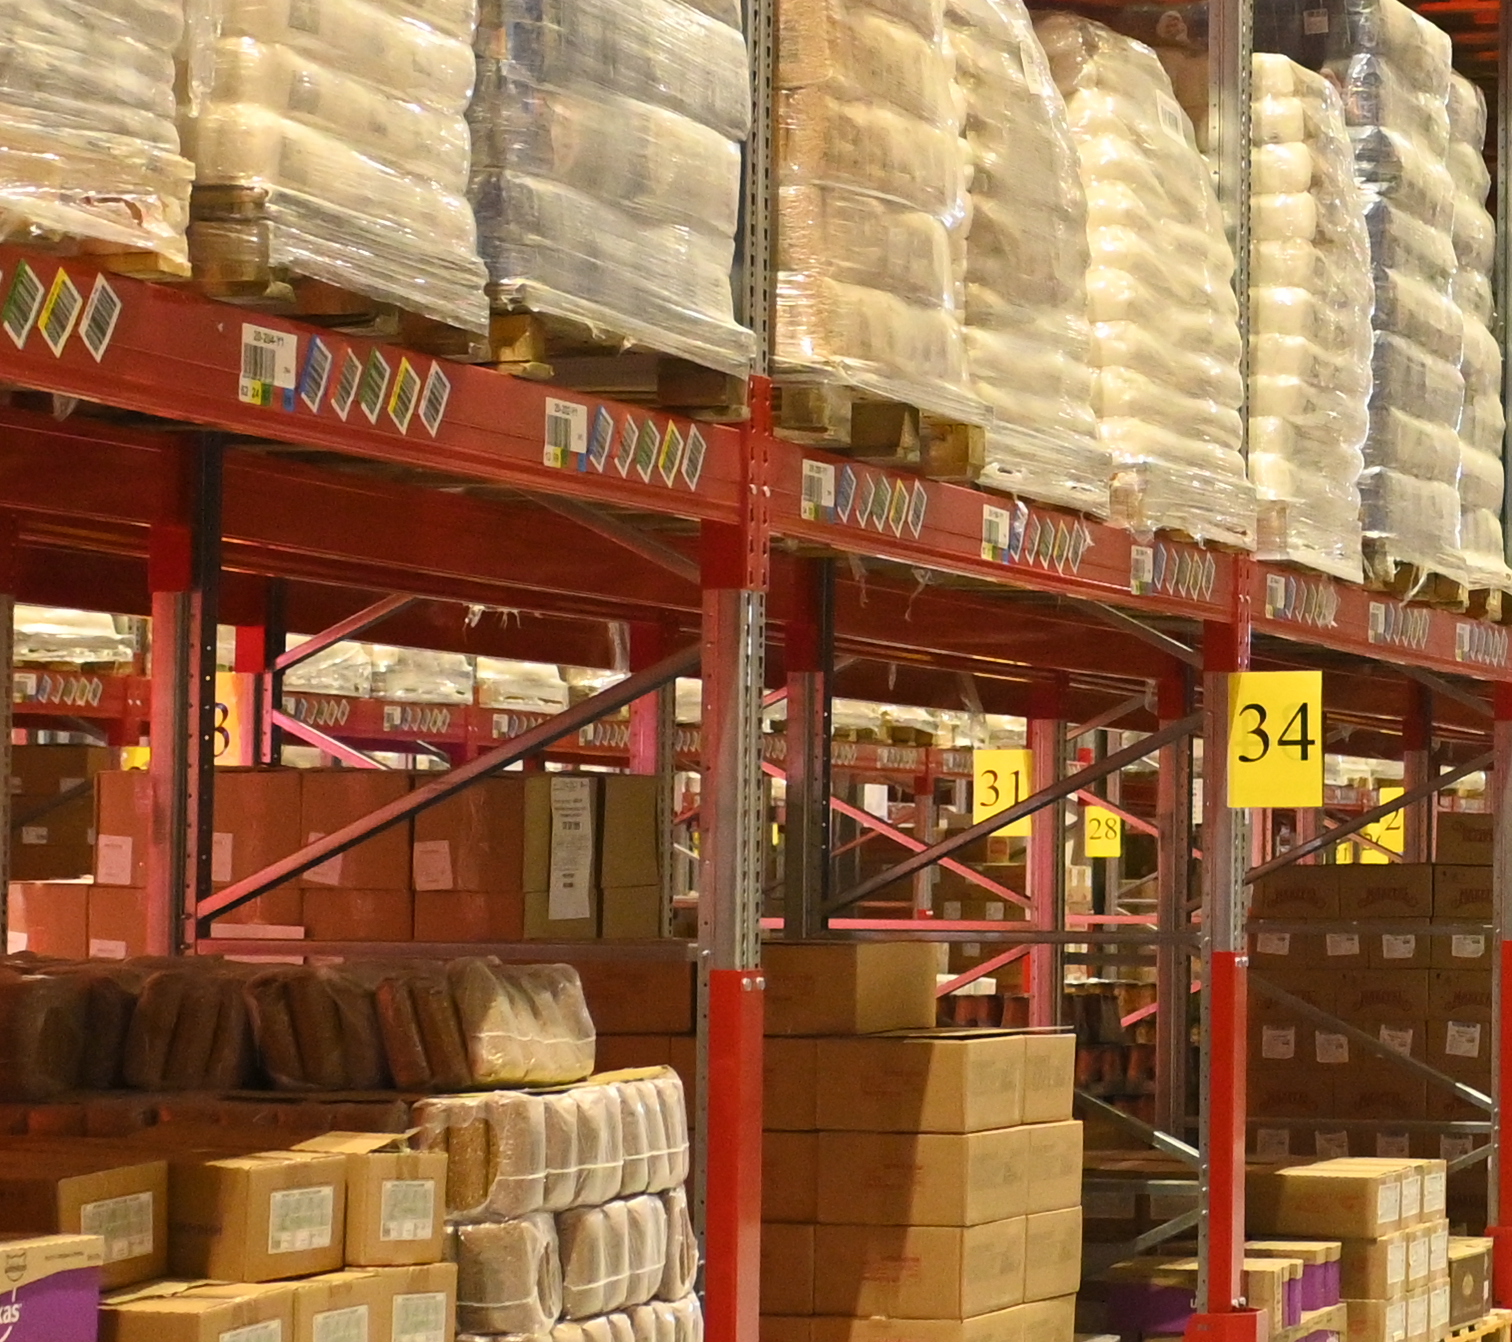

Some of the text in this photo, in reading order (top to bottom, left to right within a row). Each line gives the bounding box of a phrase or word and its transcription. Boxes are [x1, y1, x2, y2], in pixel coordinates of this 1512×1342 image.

[214, 701, 230, 758] 3
[1238, 702, 1316, 763] 34
[979, 769, 1021, 808] 31
[1089, 818, 1118, 840] 28
